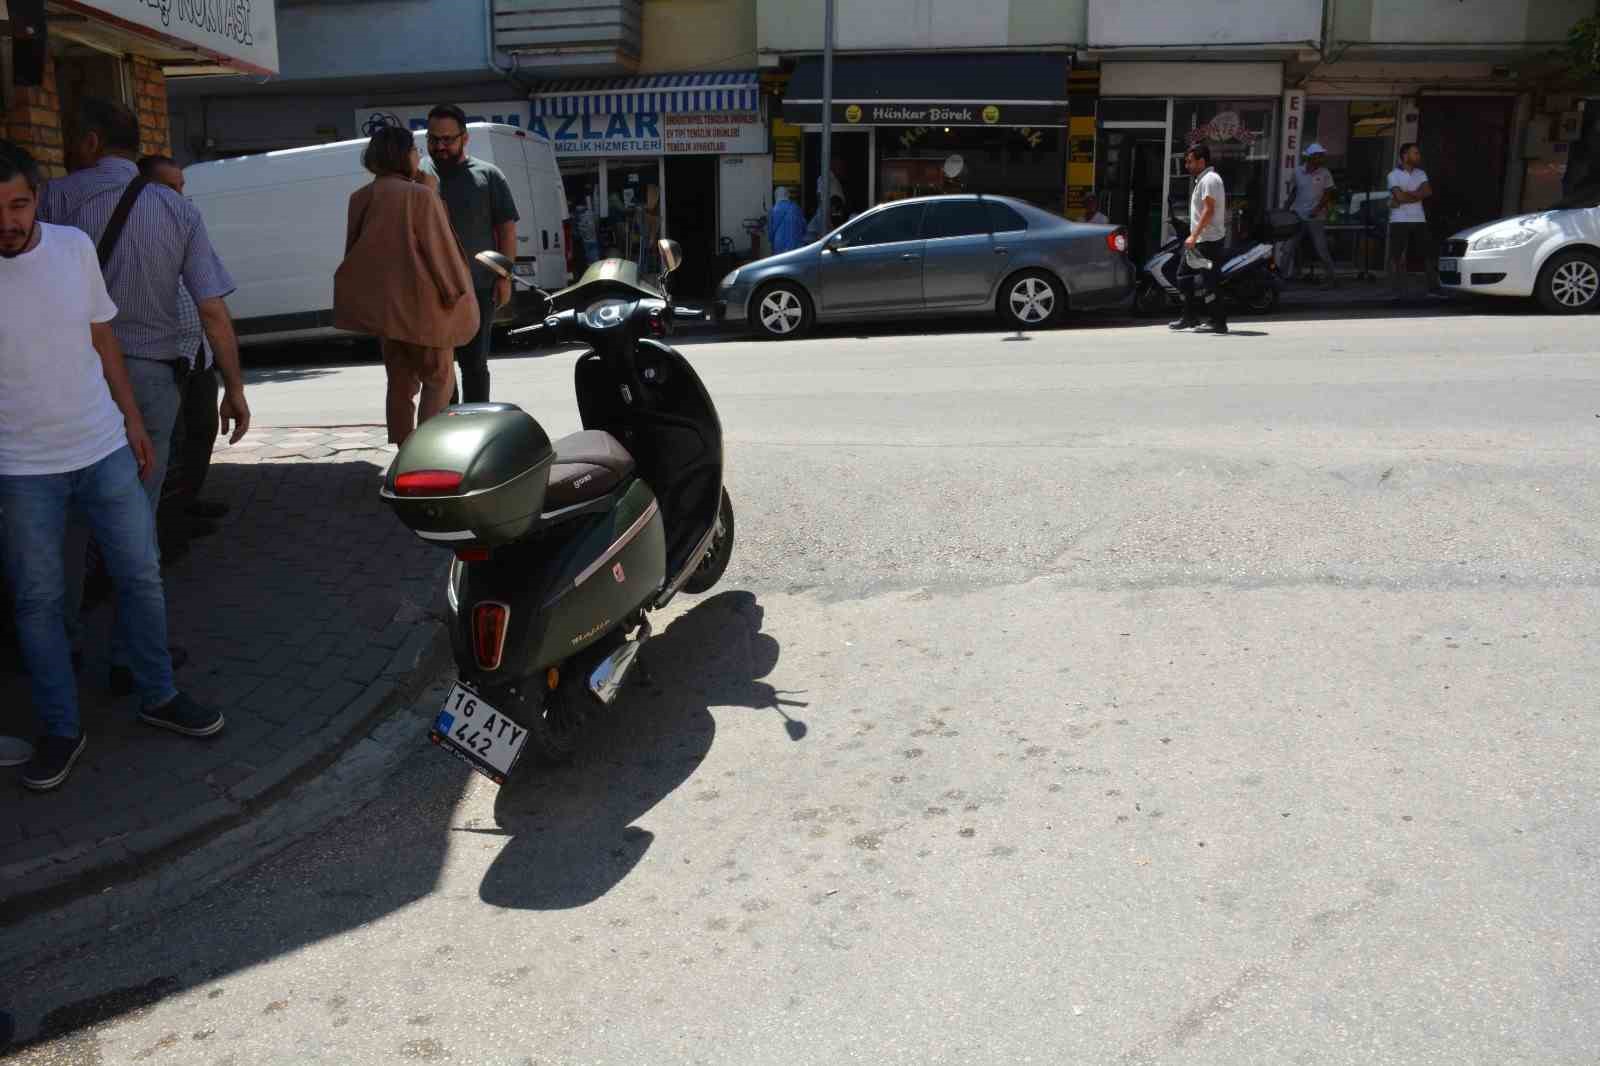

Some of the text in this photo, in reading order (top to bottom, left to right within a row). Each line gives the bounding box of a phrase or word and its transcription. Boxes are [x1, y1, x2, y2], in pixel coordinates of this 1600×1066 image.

[872, 106, 972, 121] Hünkar Börek
[454, 693, 523, 746] 16 ATY
[456, 724, 493, 757] 442
